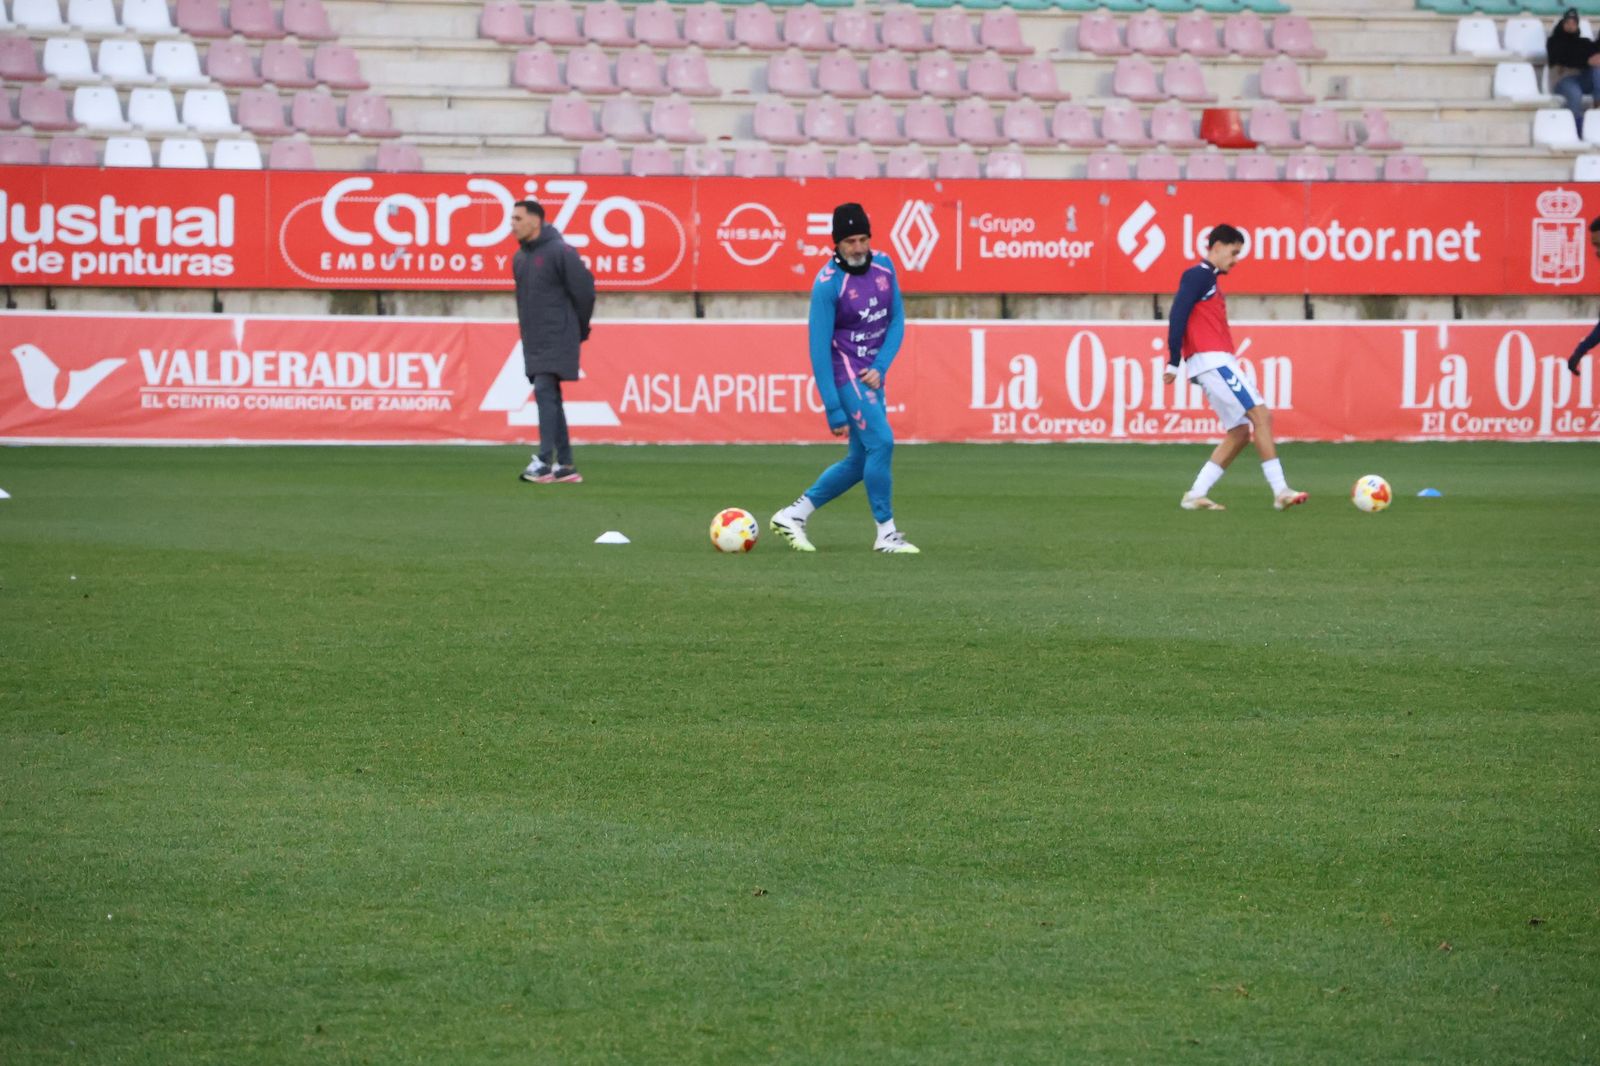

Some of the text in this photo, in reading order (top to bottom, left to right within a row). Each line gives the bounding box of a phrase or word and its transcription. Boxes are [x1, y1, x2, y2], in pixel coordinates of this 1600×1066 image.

[0, 190, 234, 247] ustrial
[979, 213, 1035, 237] Grupo
[717, 227, 786, 241] NISSAN
[980, 237, 1094, 259] Leomotor
[11, 245, 234, 280] de pinturas
[321, 252, 484, 272] EMBUTIDOS
[495, 255, 507, 271] Y
[139, 349, 448, 388] VALDERADUEY
[969, 329, 1042, 411] La
[1400, 329, 1471, 410] La
[141, 394, 452, 412] EL CENTRO COMERCIAL DE ZAMORA
[992, 413, 1016, 434] El
[1022, 413, 1106, 434] Correo
[1129, 413, 1158, 434] de
[1421, 412, 1445, 433] El
[1450, 412, 1533, 433] Correo
[1556, 410, 1586, 432] de
